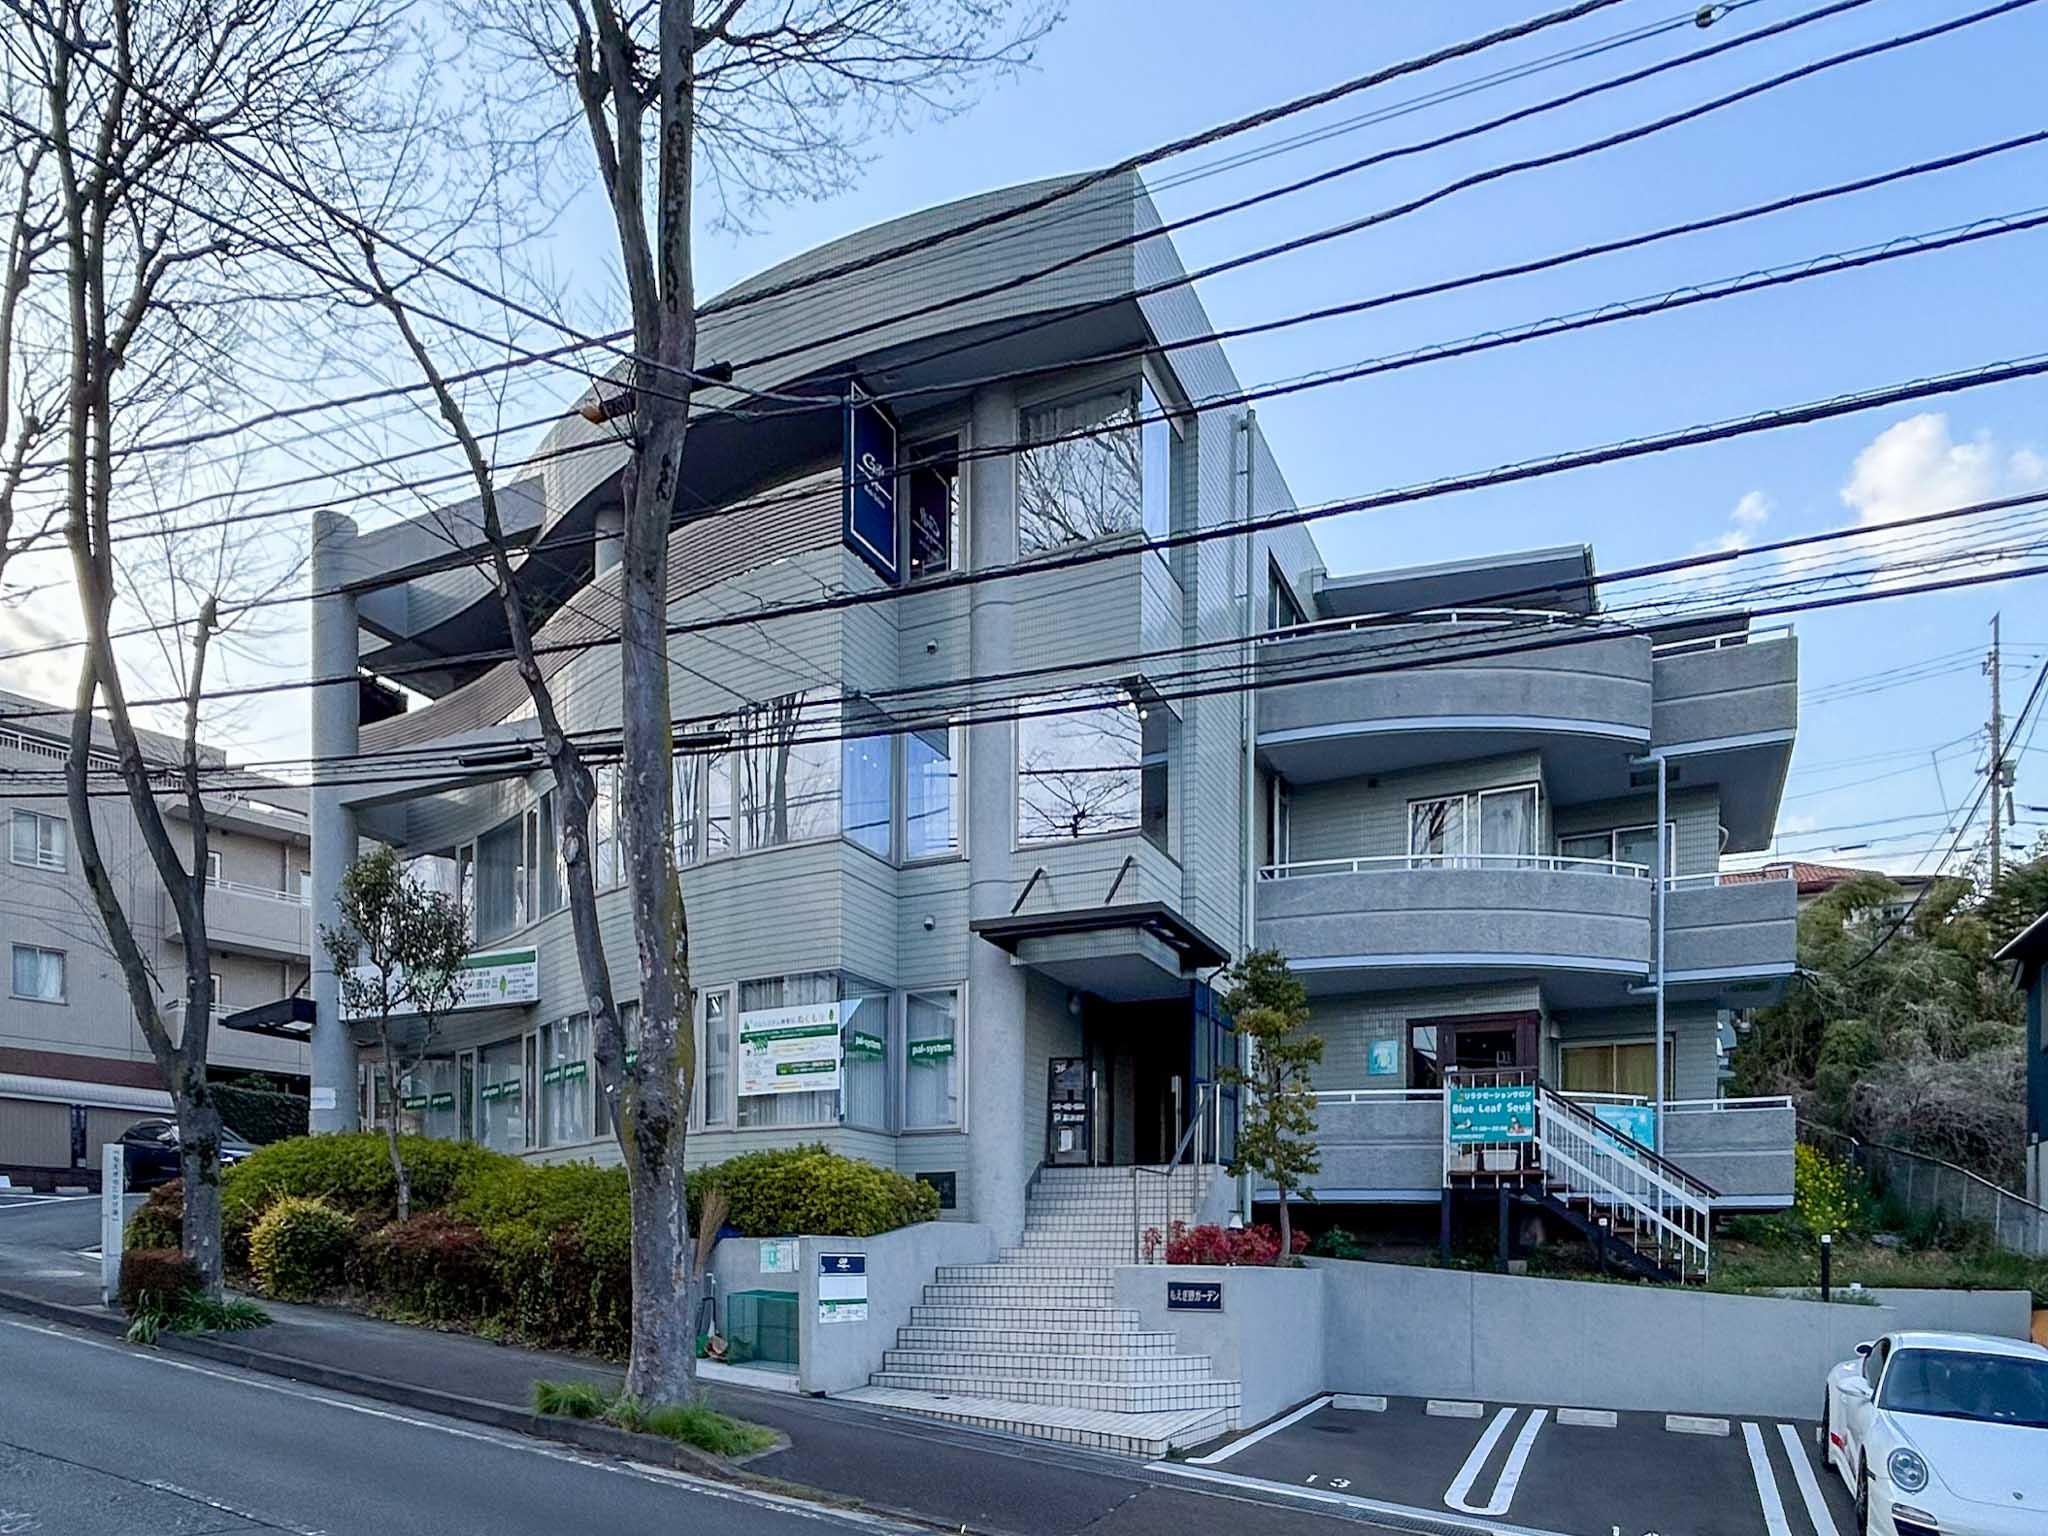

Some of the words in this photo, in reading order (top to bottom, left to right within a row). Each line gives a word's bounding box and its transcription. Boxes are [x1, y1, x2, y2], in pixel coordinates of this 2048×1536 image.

[912, 1043, 952, 1056] pal-system
[1452, 1103, 1475, 1114] Blue
[1478, 1103, 1502, 1113] Leaf
